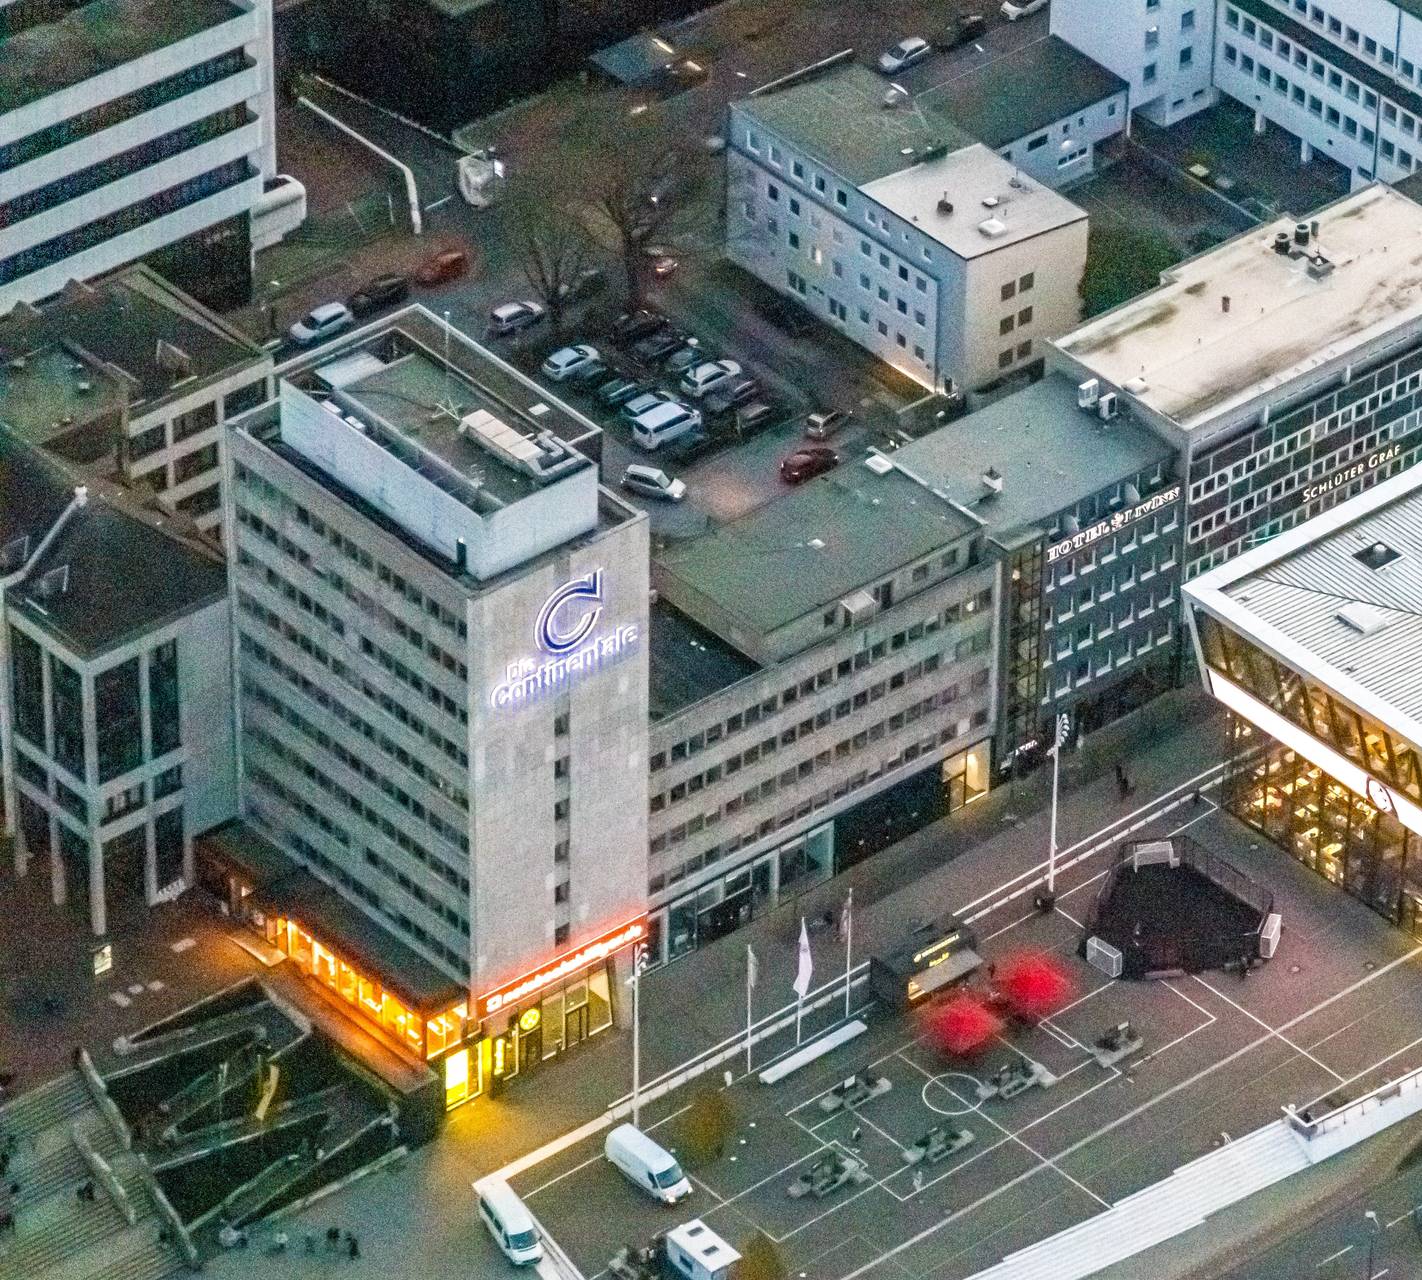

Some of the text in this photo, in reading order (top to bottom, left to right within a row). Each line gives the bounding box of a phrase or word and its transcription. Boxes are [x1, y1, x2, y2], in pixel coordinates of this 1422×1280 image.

[1368, 444, 1401, 468] GRAF
[1047, 521, 1110, 562] HOTEL
[490, 624, 639, 708] Continentale
